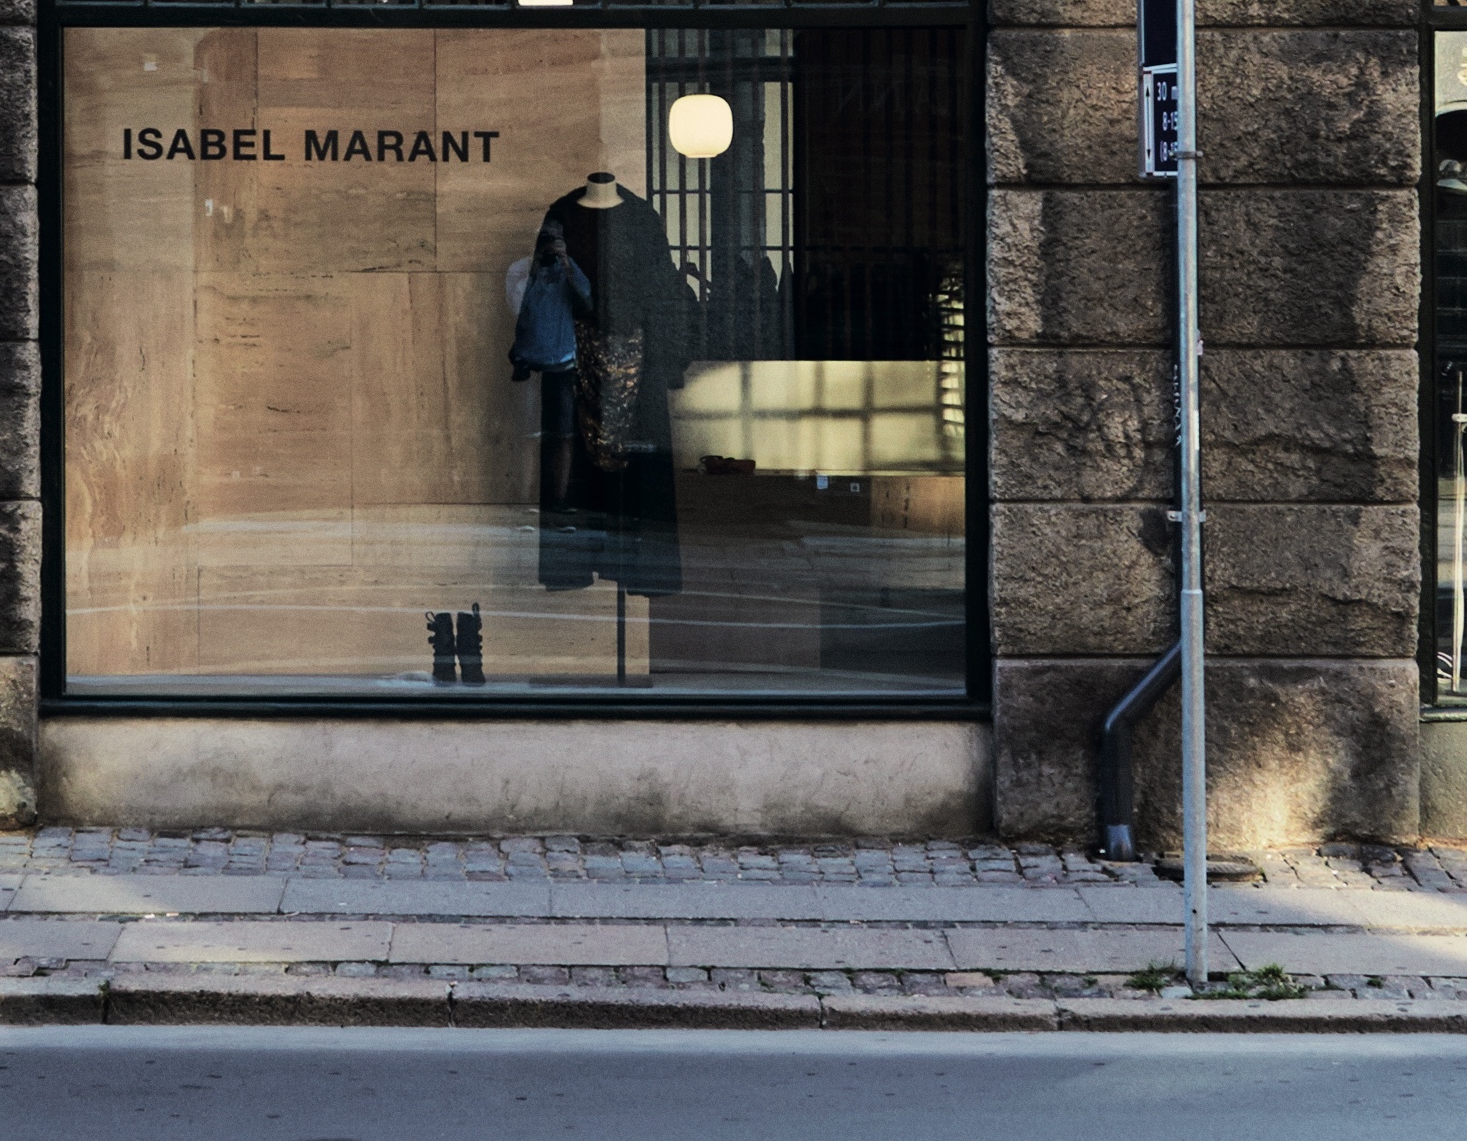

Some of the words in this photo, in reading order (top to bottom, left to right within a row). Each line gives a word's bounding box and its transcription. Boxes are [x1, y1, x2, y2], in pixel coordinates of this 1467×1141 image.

[1157, 81, 1168, 101] 30
[123, 127, 286, 160] ISABEL
[304, 129, 500, 163] MARANT
